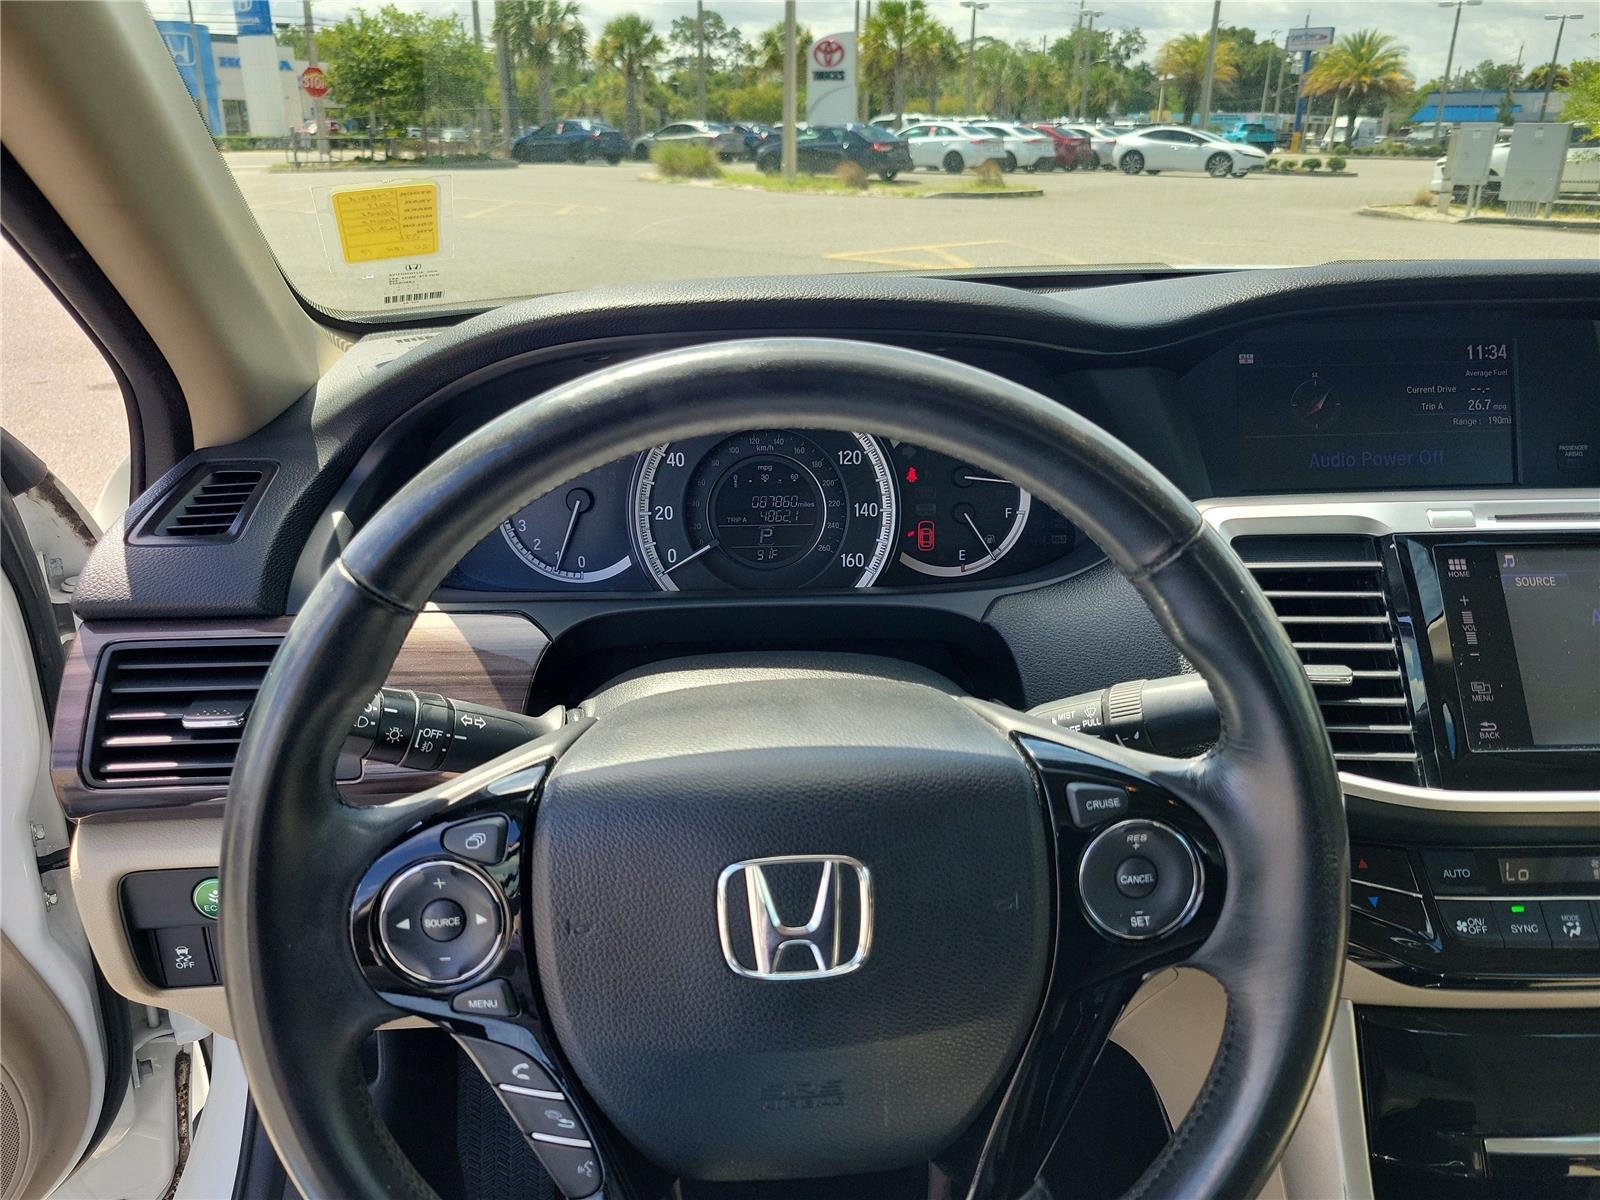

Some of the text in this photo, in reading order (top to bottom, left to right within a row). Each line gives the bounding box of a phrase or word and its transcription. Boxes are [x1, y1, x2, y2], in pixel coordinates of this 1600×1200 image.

[1466, 344, 1508, 360] 11:34
[1465, 367, 1508, 378] Average Fuel
[1406, 384, 1457, 394] Current Drive
[1421, 402, 1444, 412] Trip A
[1467, 399, 1491, 411] 26.7
[666, 452, 685, 467] 40
[838, 451, 862, 465] 120
[1309, 449, 1446, 469] Audio Power Off
[751, 495, 799, 508] 087860
[654, 506, 674, 520] 20
[854, 503, 878, 517] 140
[1005, 507, 1012, 518] F
[518, 519, 527, 532] 3
[759, 528, 773, 544] P
[533, 538, 541, 550] 2
[667, 548, 677, 563] 0
[840, 553, 864, 567] 160
[959, 550, 966, 561] E
[577, 556, 586, 568] 0
[1515, 576, 1556, 587] SOURCE
[1057, 711, 1076, 721] MIST
[1082, 718, 1102, 728] PULL
[423, 728, 443, 739] OFF
[1479, 731, 1500, 739] BACK
[1086, 797, 1121, 811] CRUISE
[1120, 874, 1154, 885] CANCEL
[1443, 868, 1471, 879] AUTO
[424, 916, 461, 928] SOURCE
[1130, 915, 1151, 928] SET
[1468, 925, 1488, 935] OFF
[1511, 924, 1539, 934] SYNC
[175, 961, 195, 969] OFF
[468, 999, 498, 1009] MENU
